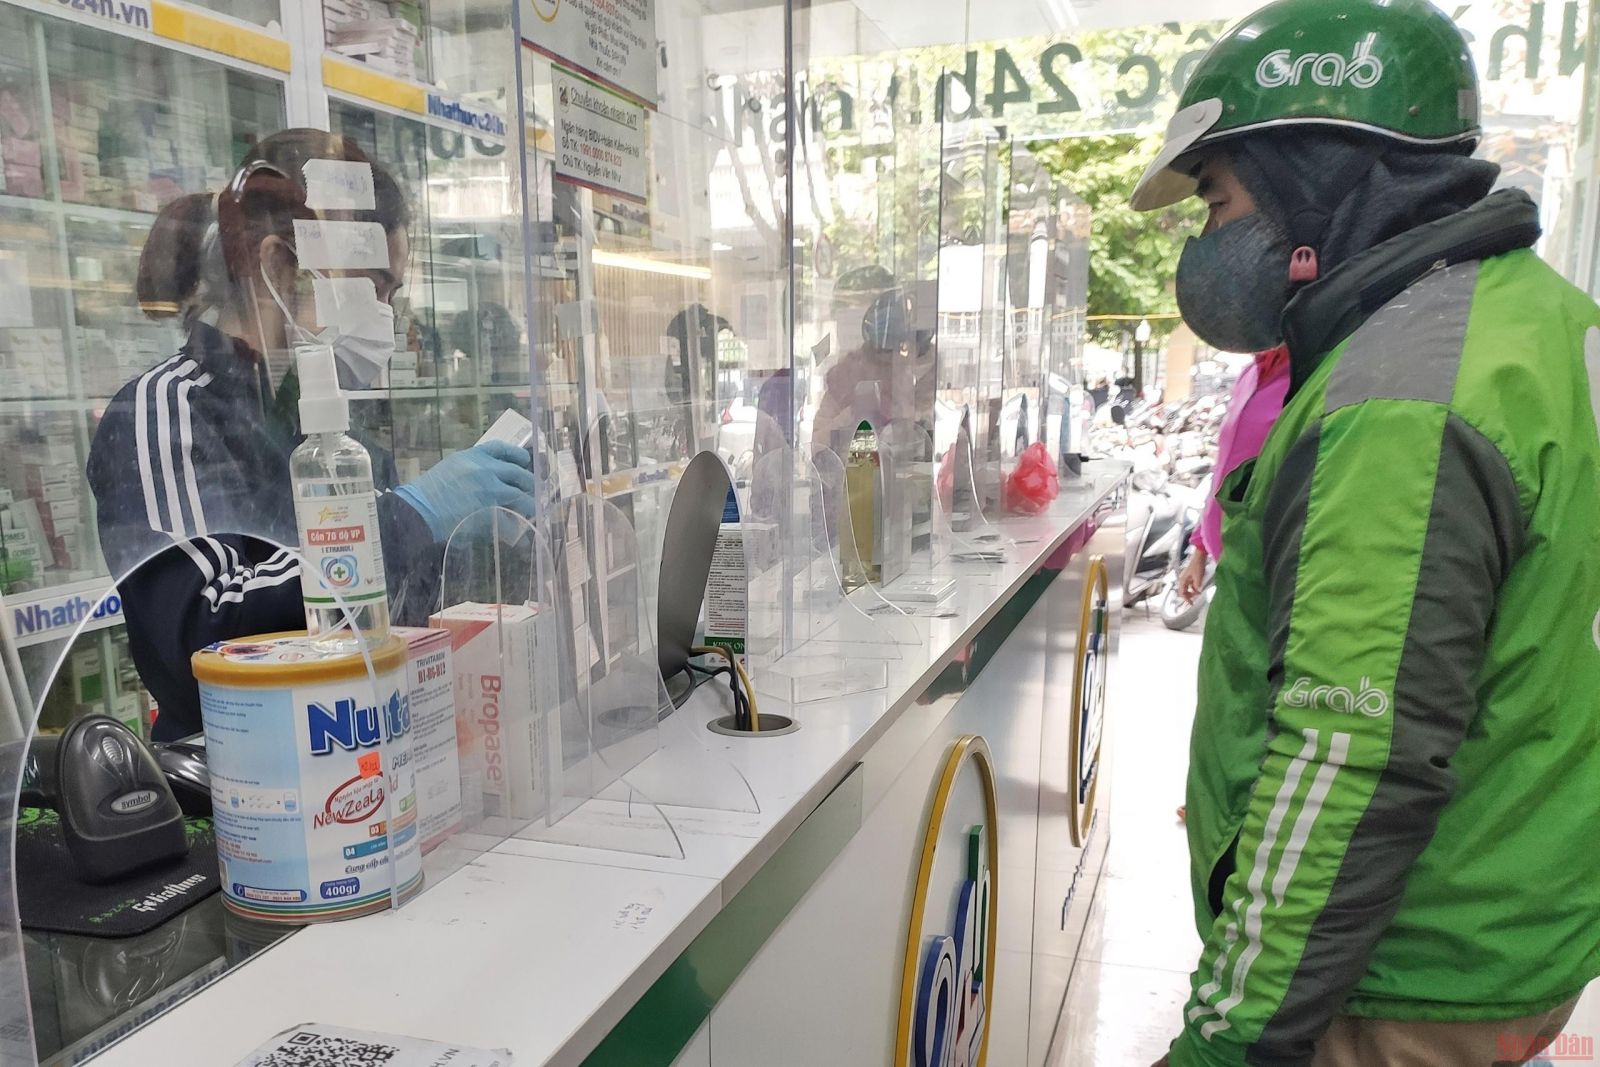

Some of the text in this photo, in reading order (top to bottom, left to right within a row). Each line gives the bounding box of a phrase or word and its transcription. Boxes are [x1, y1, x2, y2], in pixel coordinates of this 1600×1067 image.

[1255, 32, 1383, 89] Grab
[1284, 676, 1389, 717] Grab
[477, 674, 502, 785] Bropase
[326, 885, 357, 897] 400gr
